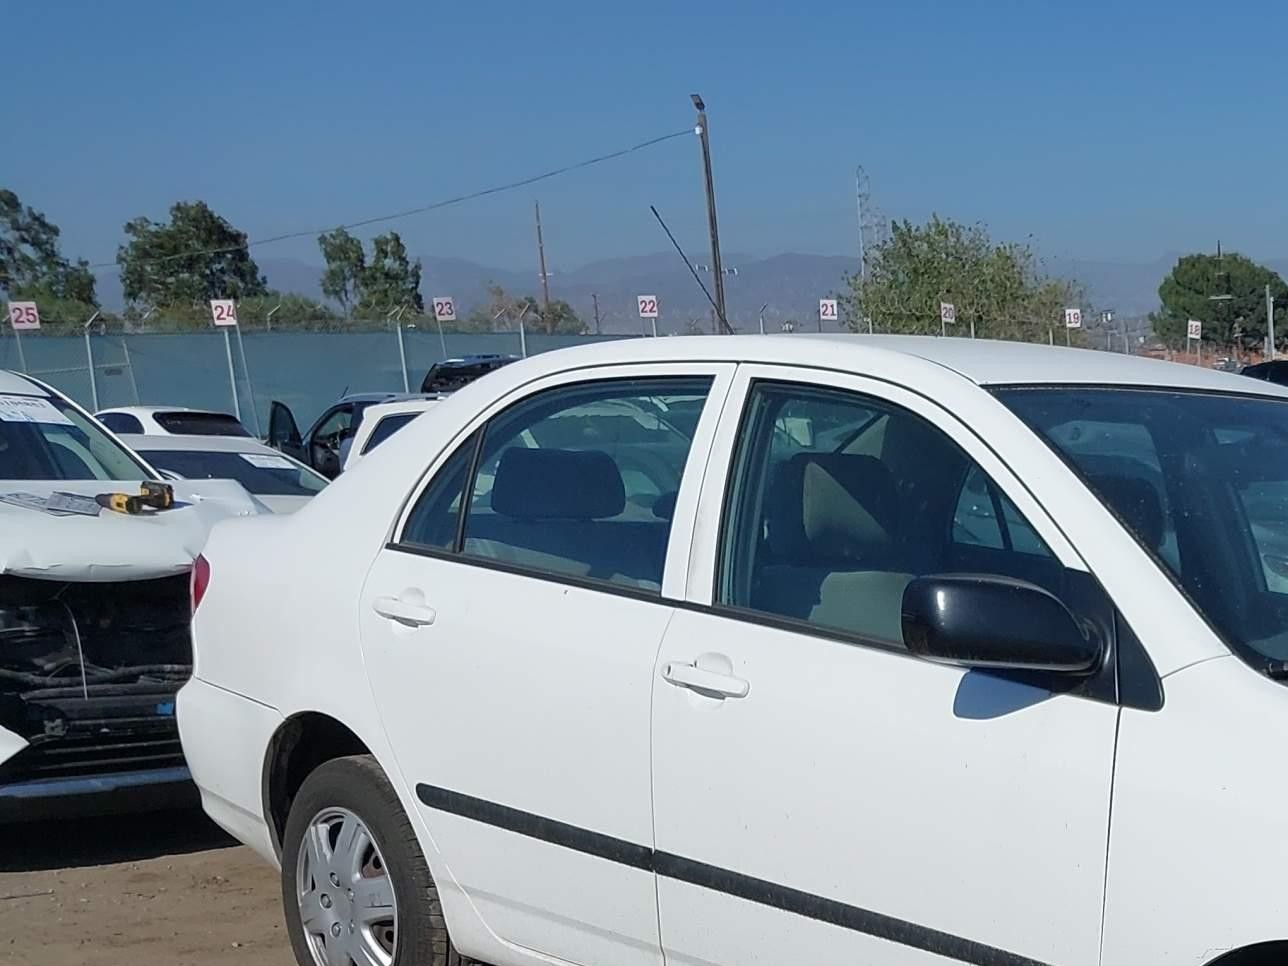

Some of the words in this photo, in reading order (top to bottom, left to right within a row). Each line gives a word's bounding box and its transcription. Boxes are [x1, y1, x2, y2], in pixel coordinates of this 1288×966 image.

[214, 305, 235, 320] 24
[436, 302, 454, 316] 23
[639, 300, 657, 314] 22
[821, 303, 836, 317] 21
[942, 306, 954, 320] 20
[11, 307, 38, 324] 25
[1066, 311, 1080, 324] 19
